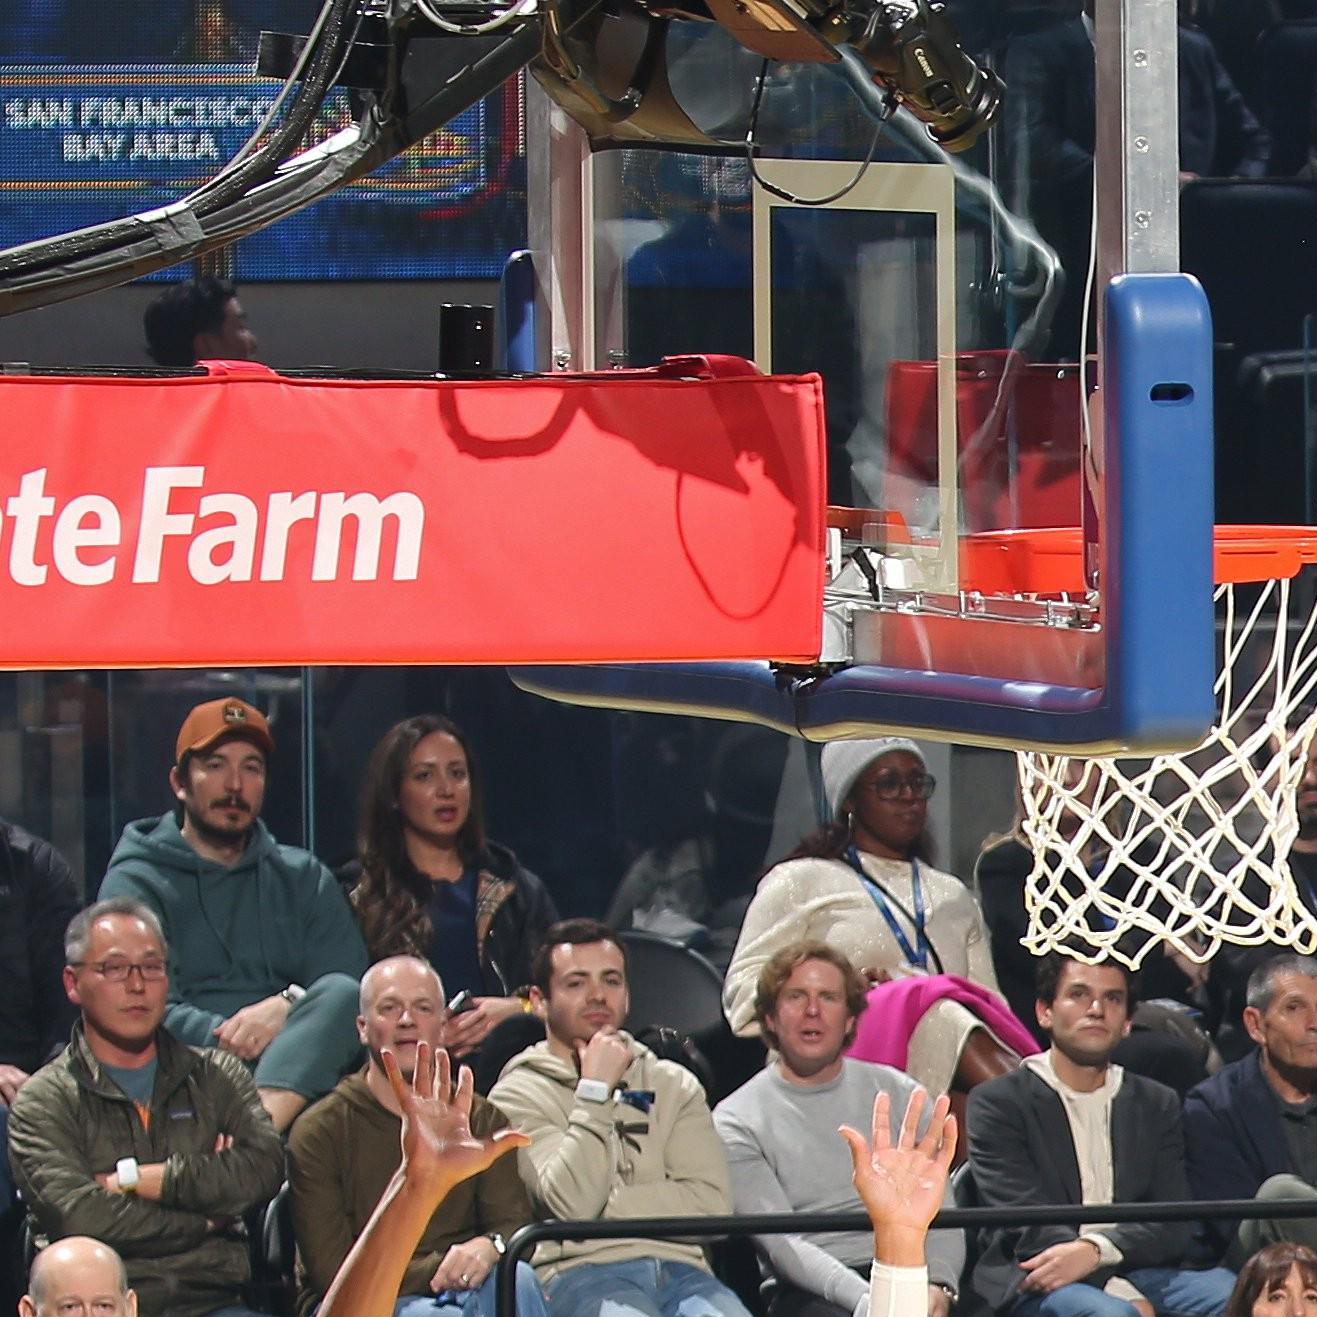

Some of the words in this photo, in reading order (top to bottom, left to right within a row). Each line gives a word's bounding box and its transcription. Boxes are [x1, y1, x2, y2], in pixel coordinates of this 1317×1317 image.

[914, 48, 934, 77] Canon
[5, 97, 73, 128] SAN
[63, 131, 127, 161] BAY
[130, 130, 220, 161] AREA
[0, 466, 426, 586] teFarm
